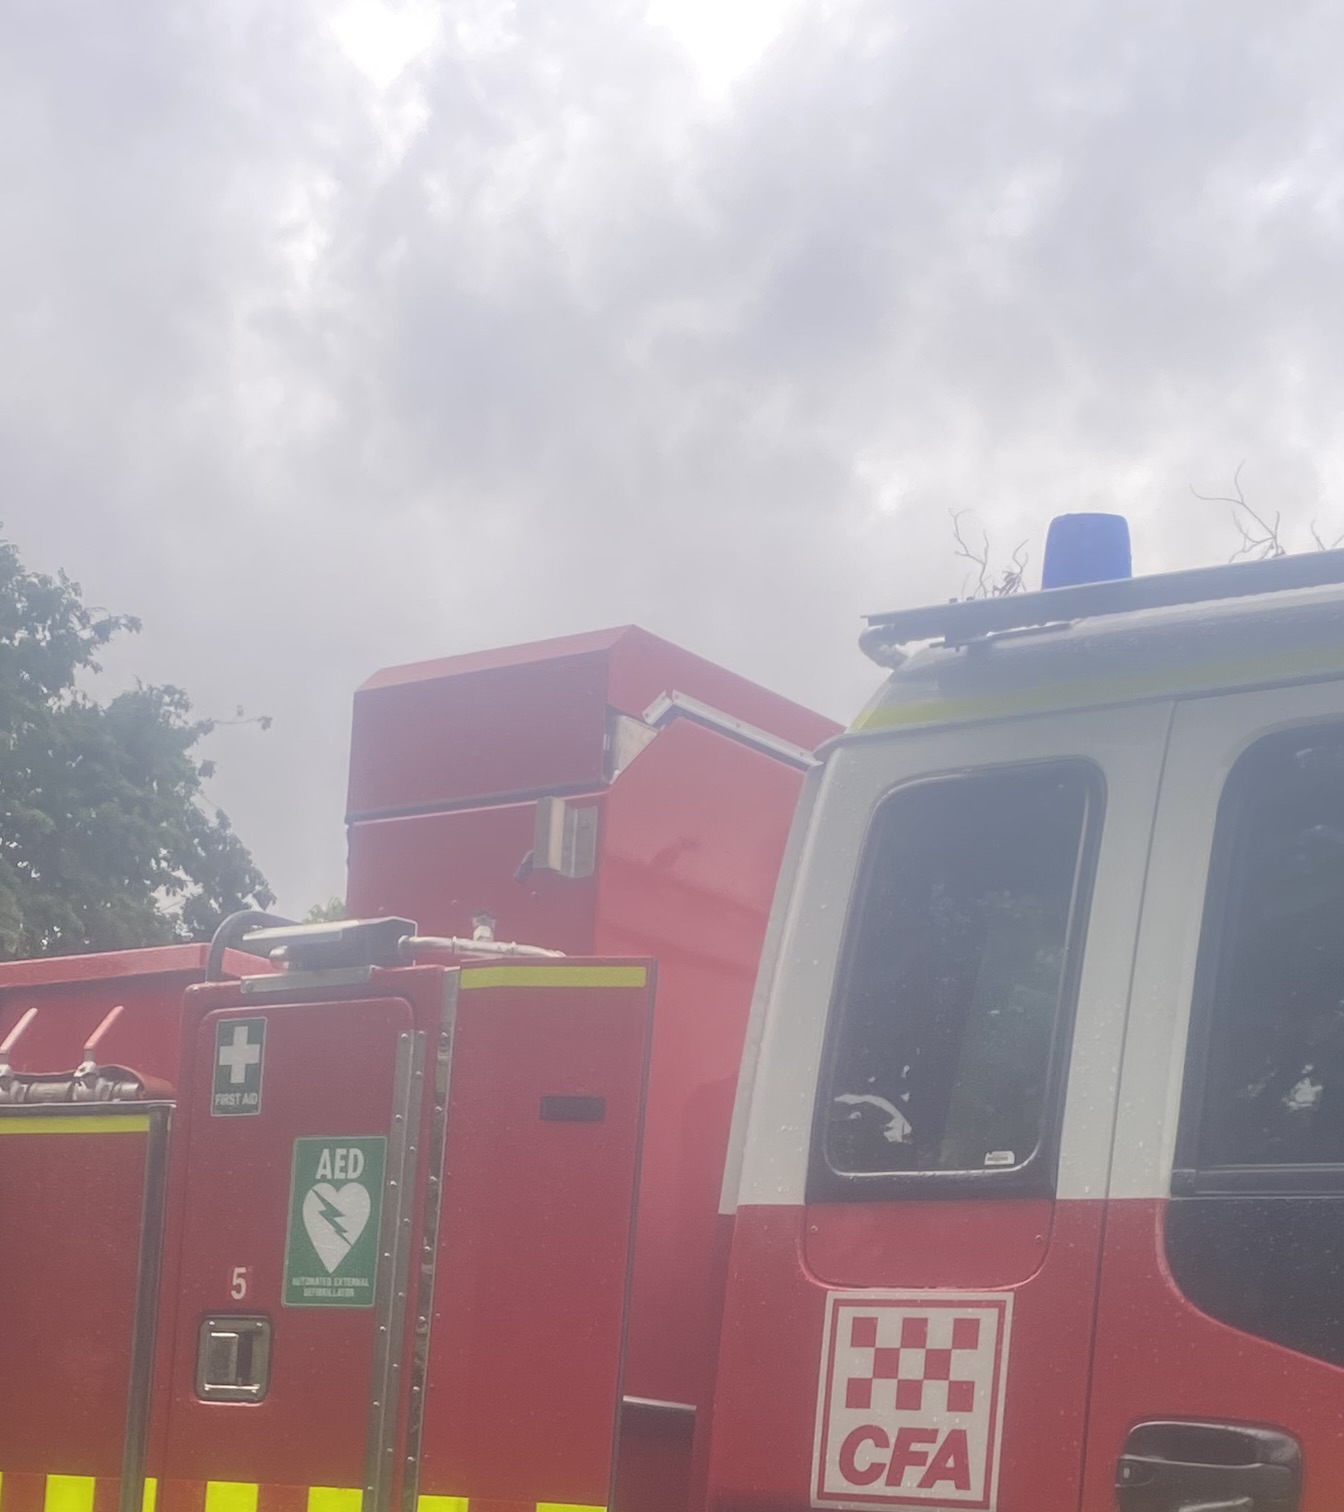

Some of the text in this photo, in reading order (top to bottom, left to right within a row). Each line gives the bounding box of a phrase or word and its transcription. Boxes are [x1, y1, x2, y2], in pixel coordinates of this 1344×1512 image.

[214, 1091, 259, 1106] FIRST AID
[314, 1147, 365, 1180] AED
[230, 1266, 247, 1300] 5
[838, 1424, 972, 1491] CFA
